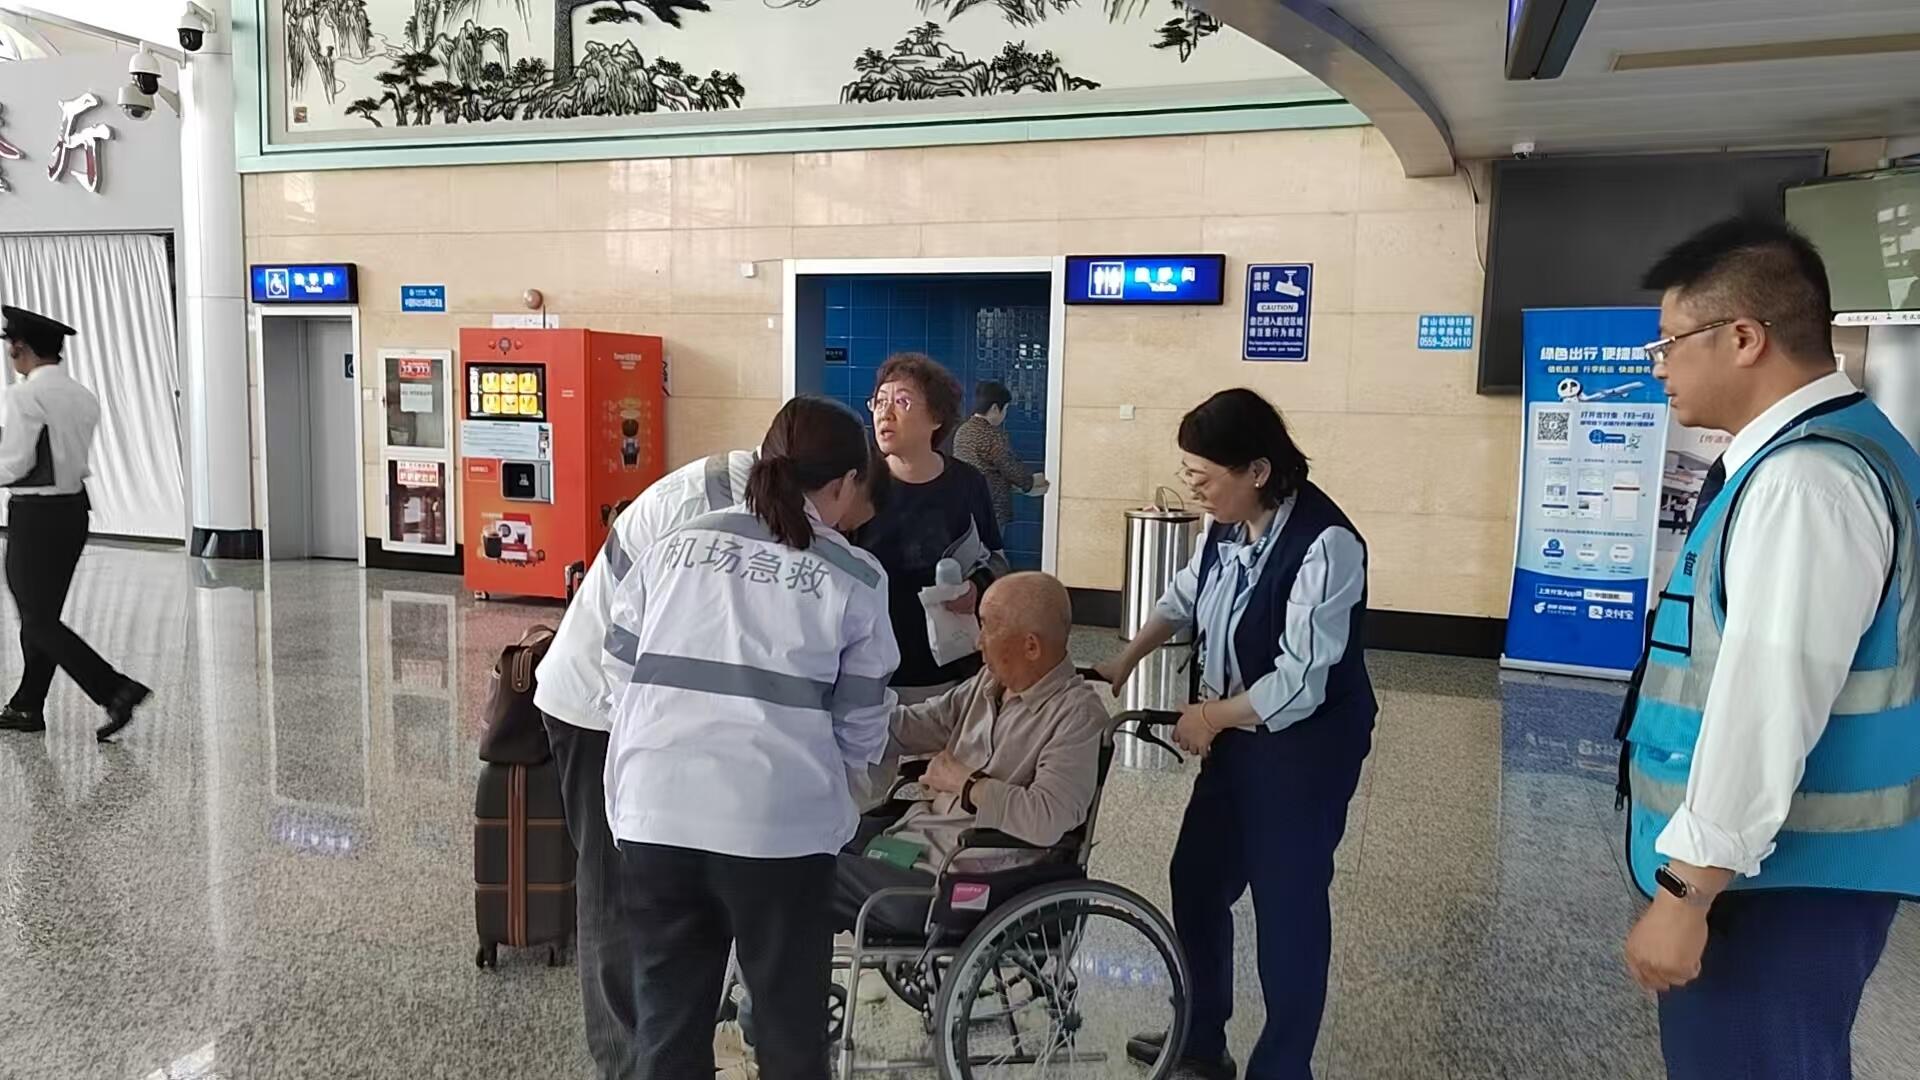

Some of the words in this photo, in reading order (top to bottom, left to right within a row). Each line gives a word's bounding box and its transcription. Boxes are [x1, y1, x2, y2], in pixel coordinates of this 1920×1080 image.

[1419, 336, 1471, 347] 0559-2934110
[1540, 346, 1598, 361] 绿色出行
[665, 536, 830, 599] 机场急救
[1604, 608, 1634, 620] 支付宝
